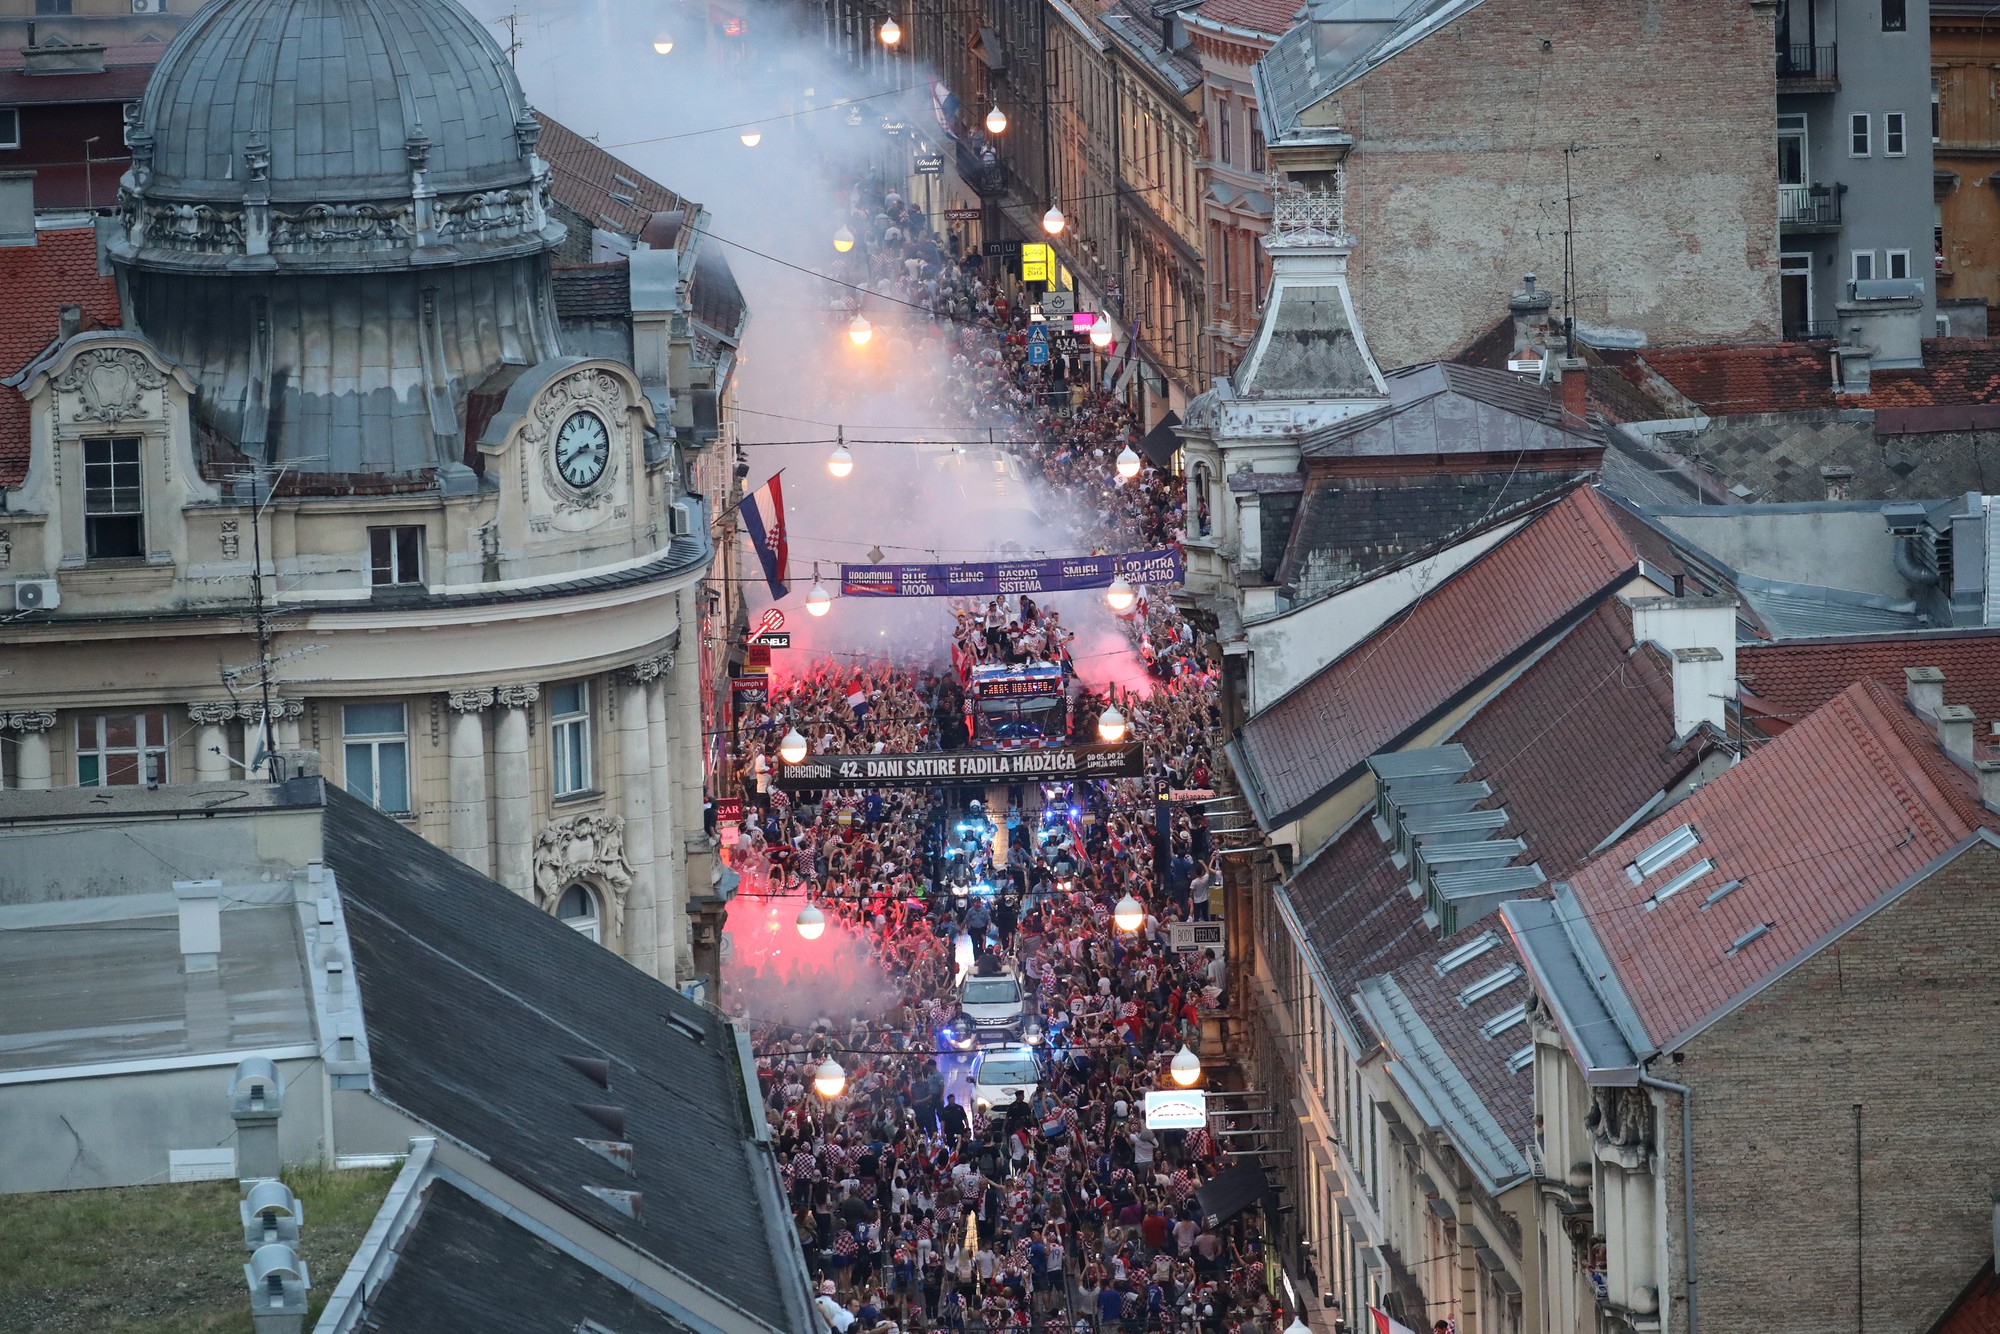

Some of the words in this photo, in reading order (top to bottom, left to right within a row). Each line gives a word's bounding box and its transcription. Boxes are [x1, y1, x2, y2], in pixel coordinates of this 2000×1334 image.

[1073, 324, 1092, 332] BIPA
[1033, 346, 1042, 359] P
[1126, 561, 1141, 572] OD
[1143, 557, 1175, 571] JUTRA
[902, 573, 927, 584] BLUE
[950, 571, 984, 583] ELLING
[998, 569, 1038, 581] RASPAD
[1149, 569, 1174, 582] STAO
[902, 585, 934, 595] MOON
[998, 580, 1042, 593] SISTEMA
[733, 680, 759, 688] Triumph
[839, 761, 863, 778] 42.
[867, 760, 903, 777] DANI
[906, 758, 957, 776] SATIRE
[959, 756, 1010, 775] FADILA
[1013, 749, 1076, 772] HADŽIĆA
[1158, 782, 1166, 792] P
[717, 805, 740, 815] GAR
[867, 802, 873, 811] 9
[767, 820, 773, 829] 7
[885, 864, 890, 872] 9
[1177, 929, 1193, 942] BODY
[1195, 928, 1218, 942] FEELING
[968, 1181, 974, 1189] 5
[1052, 1248, 1060, 1260] 19
